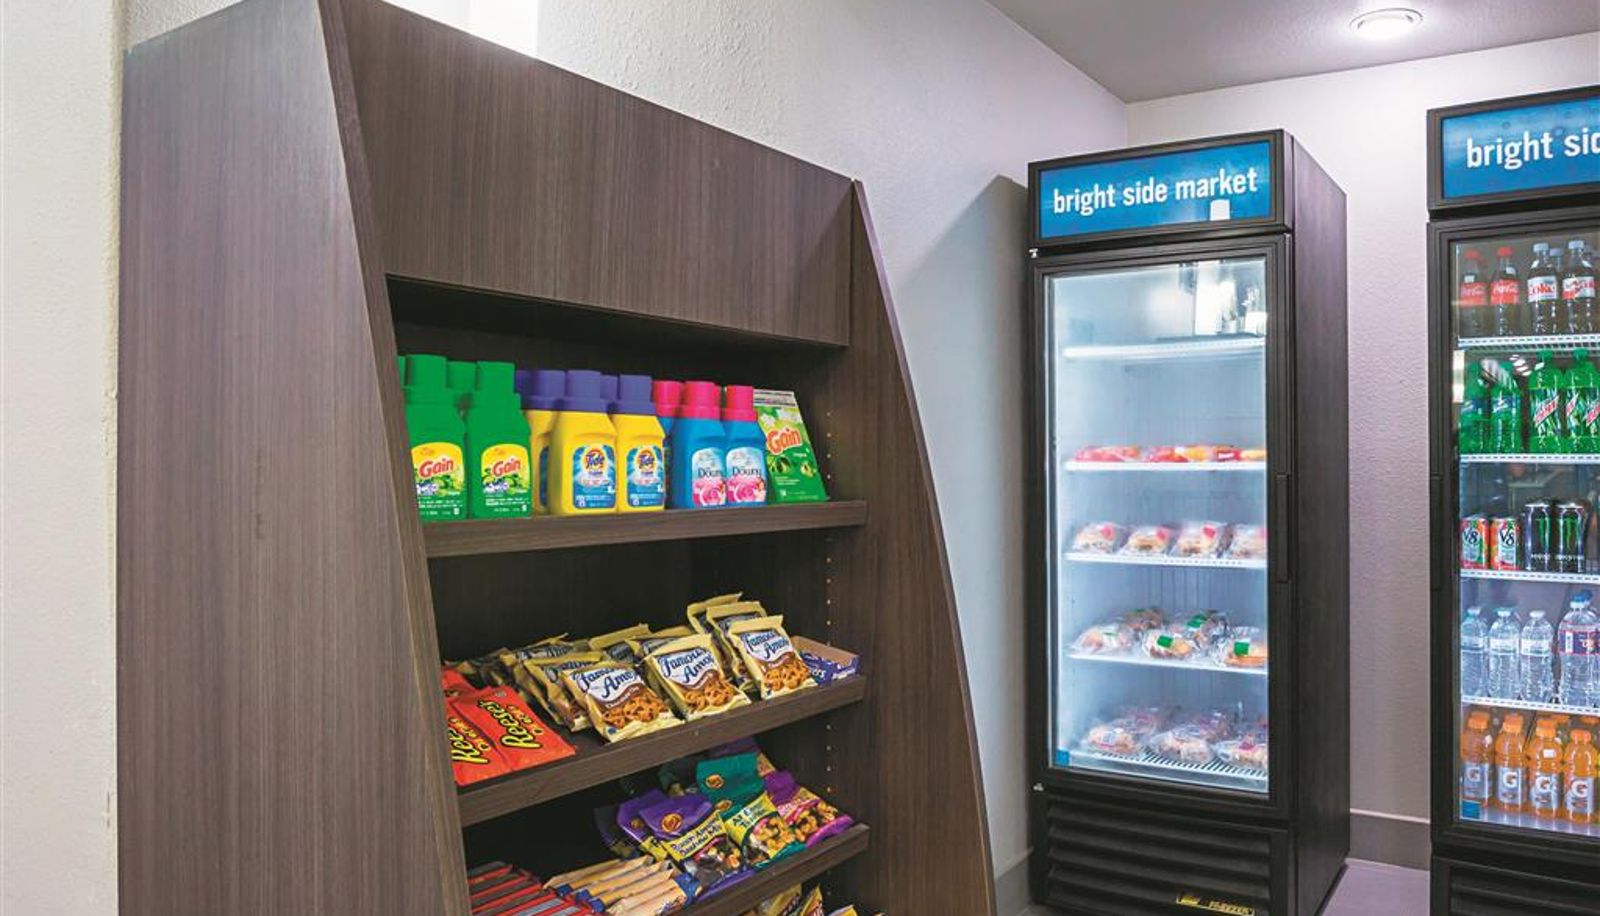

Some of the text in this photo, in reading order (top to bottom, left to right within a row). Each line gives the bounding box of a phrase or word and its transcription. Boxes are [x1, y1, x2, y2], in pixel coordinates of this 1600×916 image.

[1465, 131, 1554, 170] bright
[1053, 166, 1258, 217] bright side market
[766, 426, 802, 455] Gain
[418, 457, 454, 479] Gain
[492, 457, 521, 477] Gain
[1463, 528, 1479, 544] V8
[1499, 527, 1515, 545] V8
[1503, 771, 1518, 788] G
[1535, 776, 1551, 793] G
[1571, 780, 1588, 798] G
